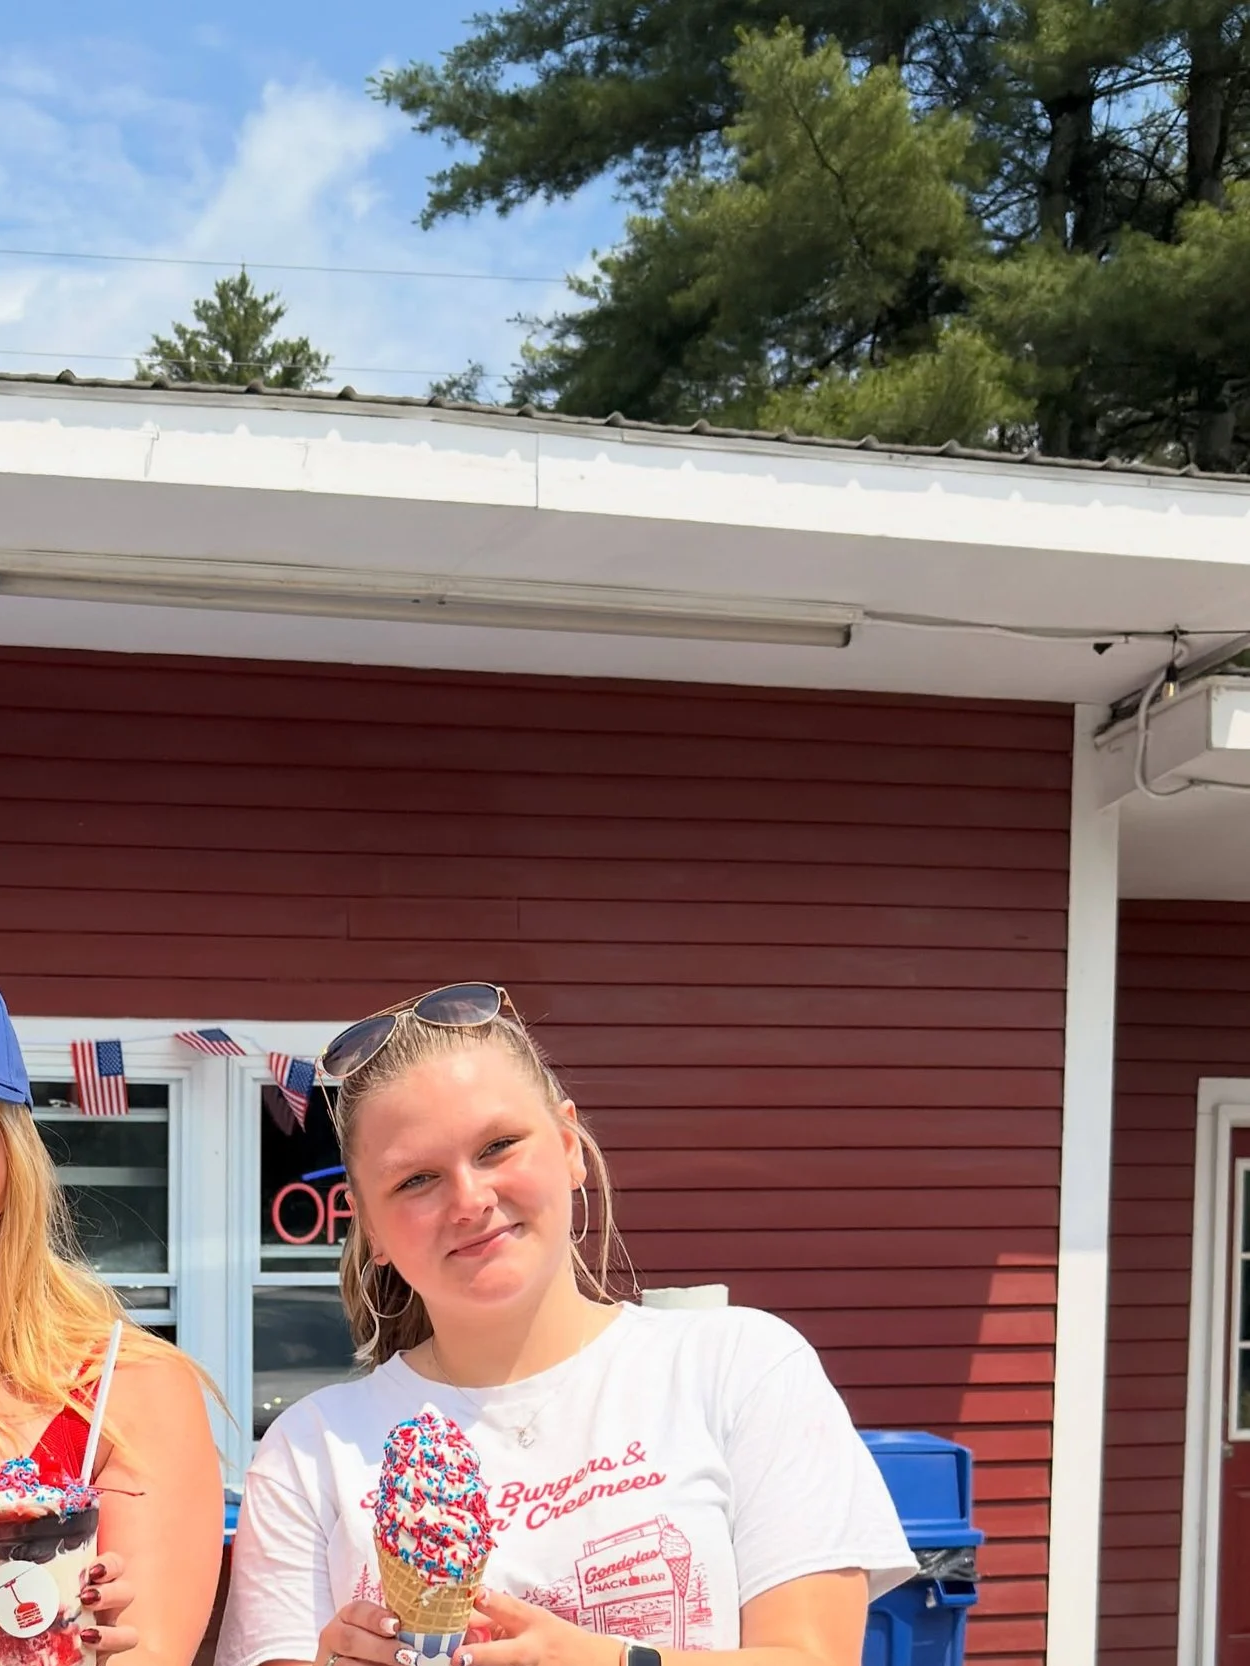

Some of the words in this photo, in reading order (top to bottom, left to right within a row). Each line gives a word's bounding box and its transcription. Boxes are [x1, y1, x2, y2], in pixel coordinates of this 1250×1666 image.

[496, 1456, 618, 1510] Burgers
[623, 1440, 647, 1466] &
[526, 1472, 666, 1531] Creemees
[583, 1548, 663, 1586] Gondolas
[585, 1578, 628, 1596] SNACK
[641, 1572, 666, 1584] BAR
